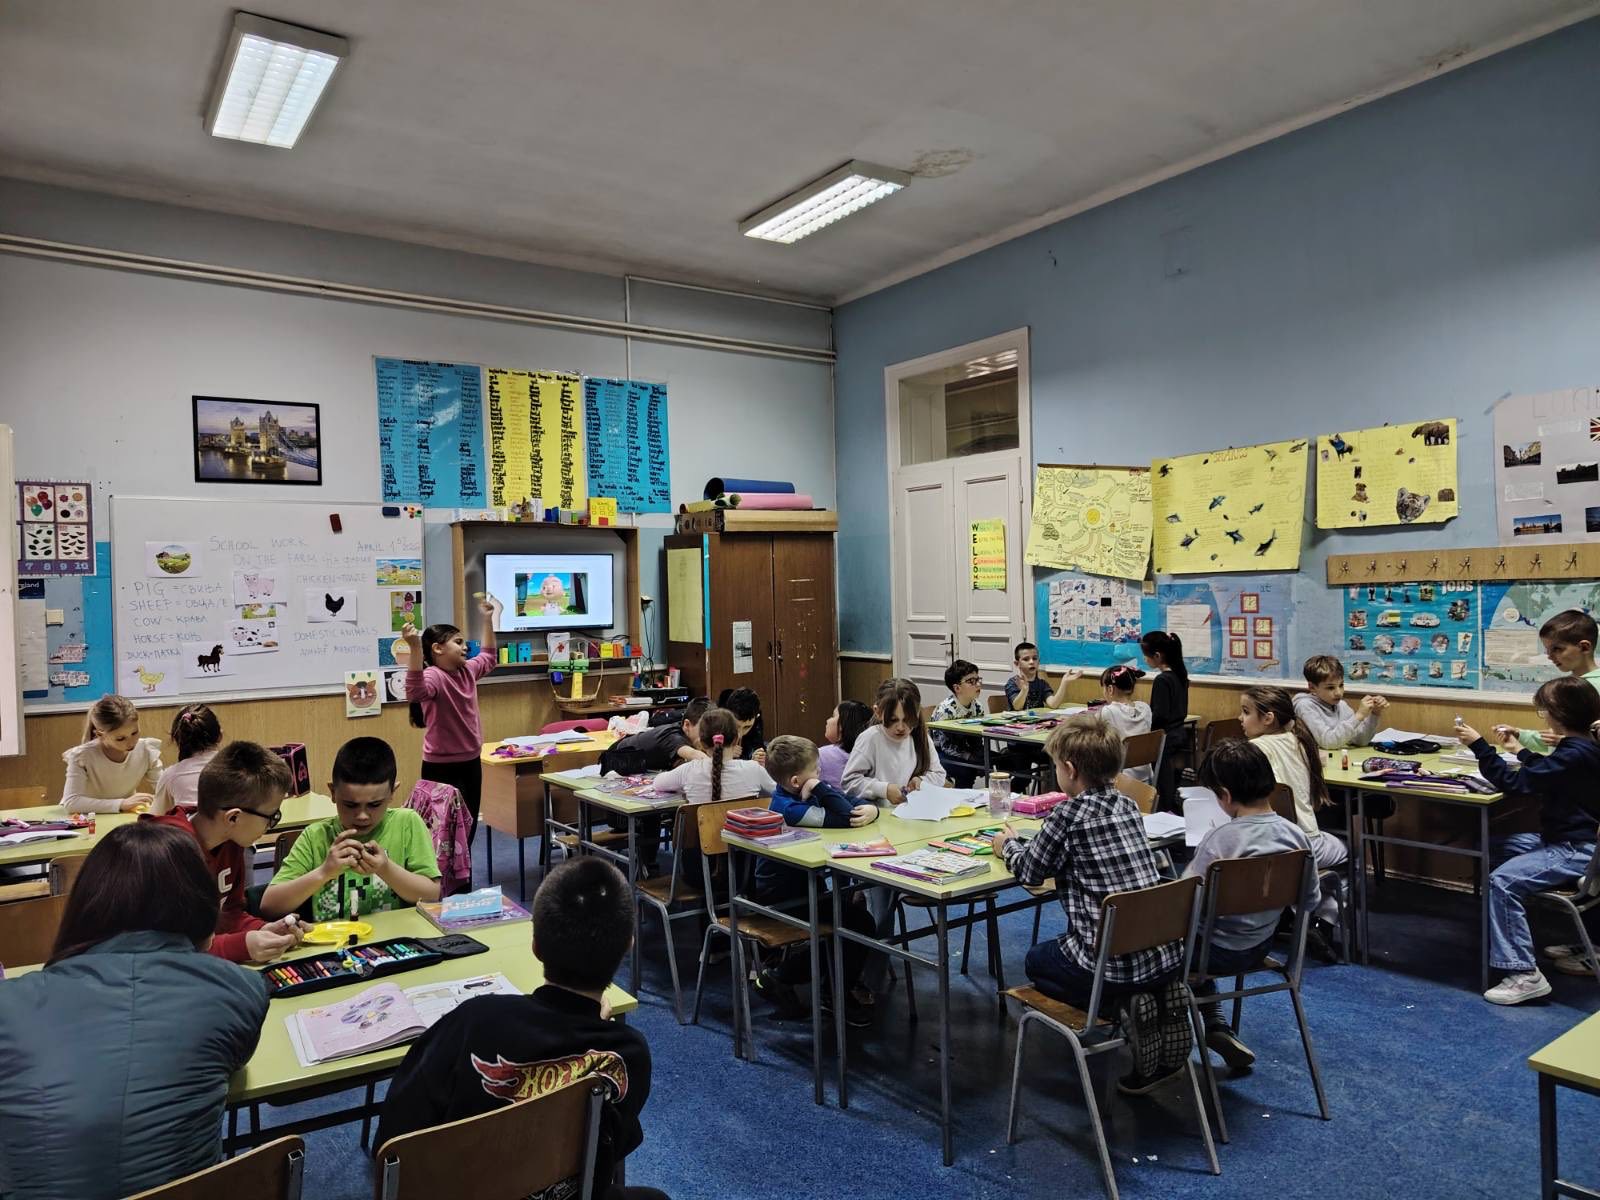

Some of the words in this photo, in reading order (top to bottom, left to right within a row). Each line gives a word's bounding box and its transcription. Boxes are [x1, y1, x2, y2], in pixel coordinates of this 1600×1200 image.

[25, 562, 33, 570] 7
[43, 562, 51, 570] 8
[60, 562, 67, 570] 9
[74, 562, 89, 570] 10
[133, 580, 165, 598] PIG
[129, 599, 172, 612] SHEEP
[133, 616, 162, 628] COW
[134, 633, 167, 645] HORSE
